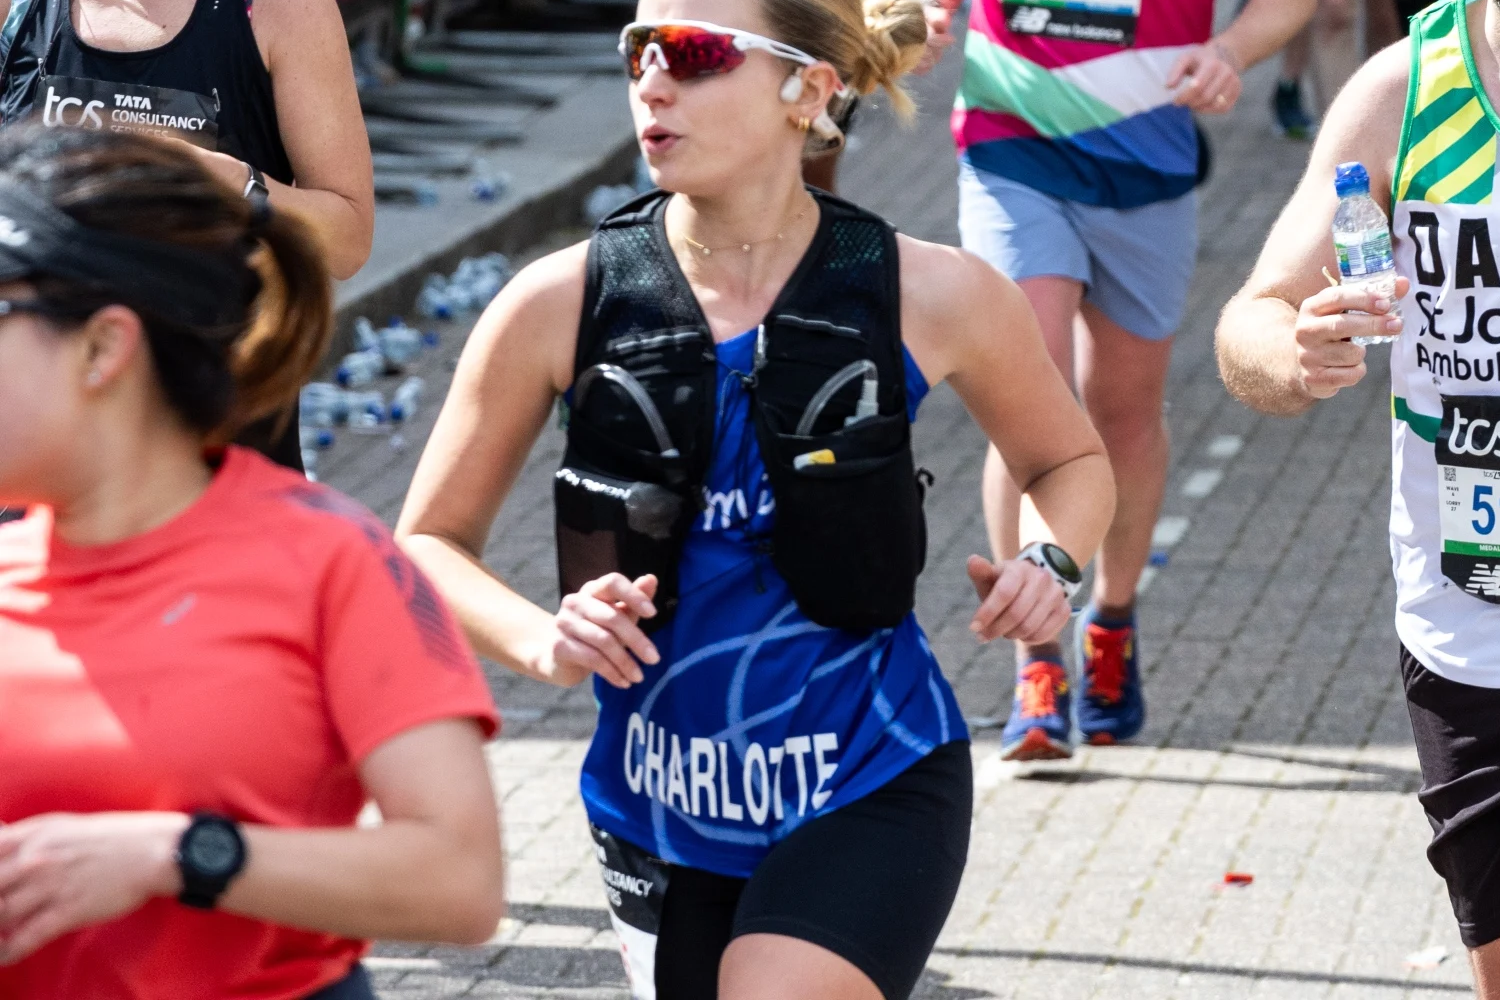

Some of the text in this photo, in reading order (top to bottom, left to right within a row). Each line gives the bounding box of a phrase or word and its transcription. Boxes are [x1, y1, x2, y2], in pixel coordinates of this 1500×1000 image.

[1072, 21, 1125, 42] balance
[43, 86, 104, 131] tcs
[114, 94, 151, 110] TATA
[111, 109, 206, 130] CONSULTANCY
[1415, 291, 1446, 340] St
[624, 712, 839, 826] CHARLOTTE
